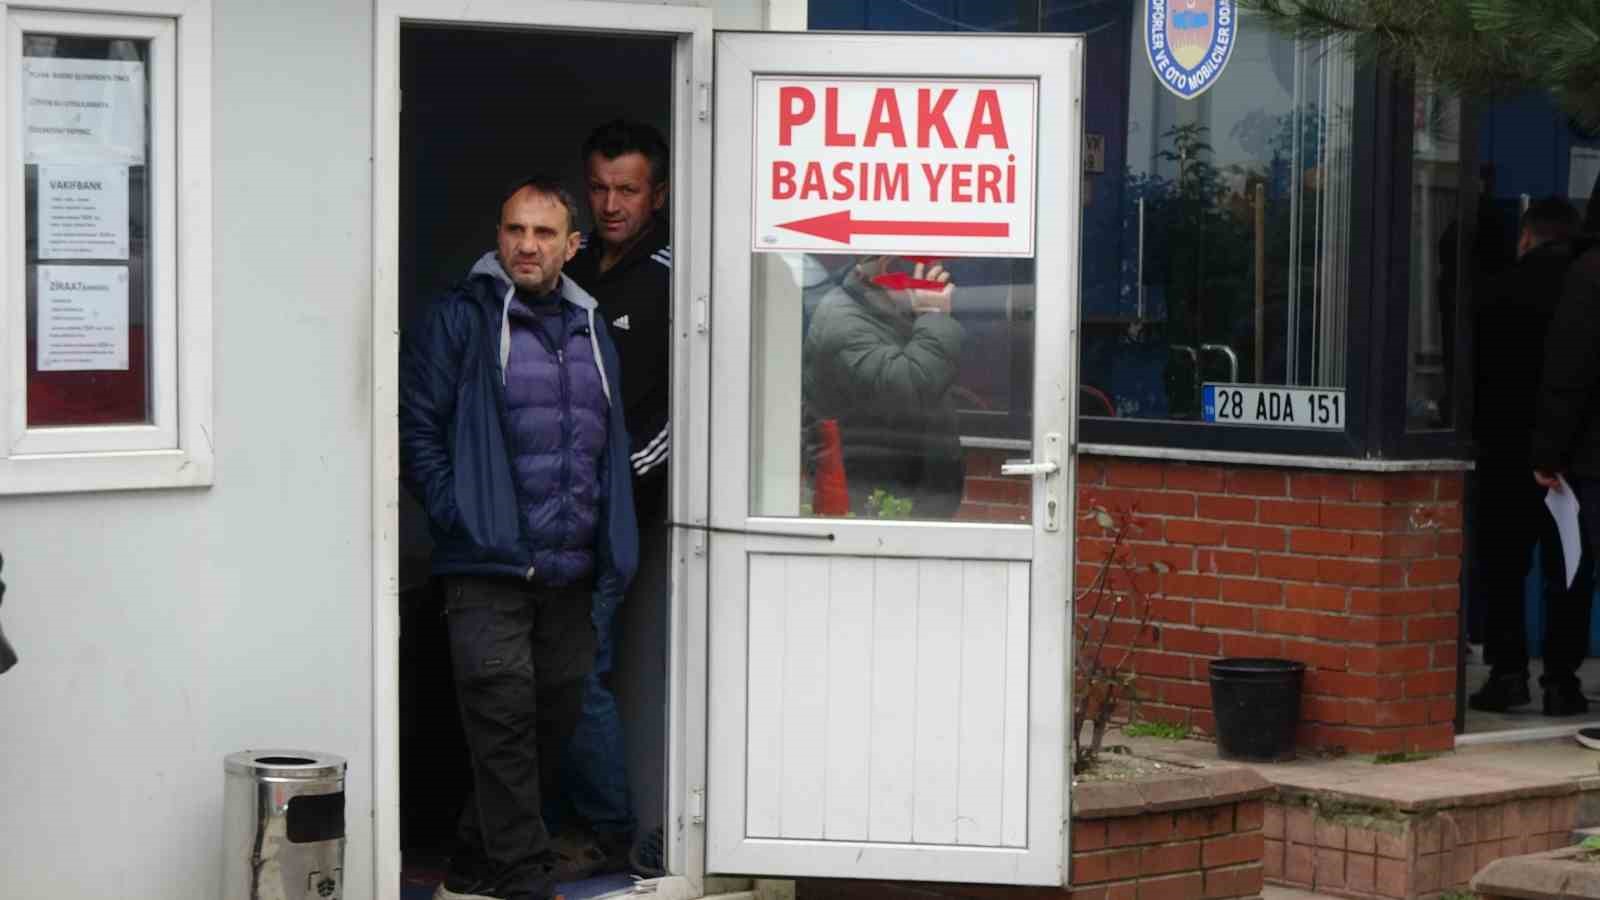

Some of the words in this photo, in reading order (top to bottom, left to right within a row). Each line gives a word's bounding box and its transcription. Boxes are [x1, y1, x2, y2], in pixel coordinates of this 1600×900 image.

[1155, 49, 1170, 72] VE
[1165, 66, 1186, 89] OTO
[778, 86, 1009, 150] PLAKA
[49, 181, 104, 192] VAKIFBANK
[771, 160, 910, 202] BASIM
[921, 153, 1017, 204] YERİ
[1218, 389, 1243, 419] 28
[1256, 391, 1295, 422] ADA
[1308, 393, 1340, 425] 151
